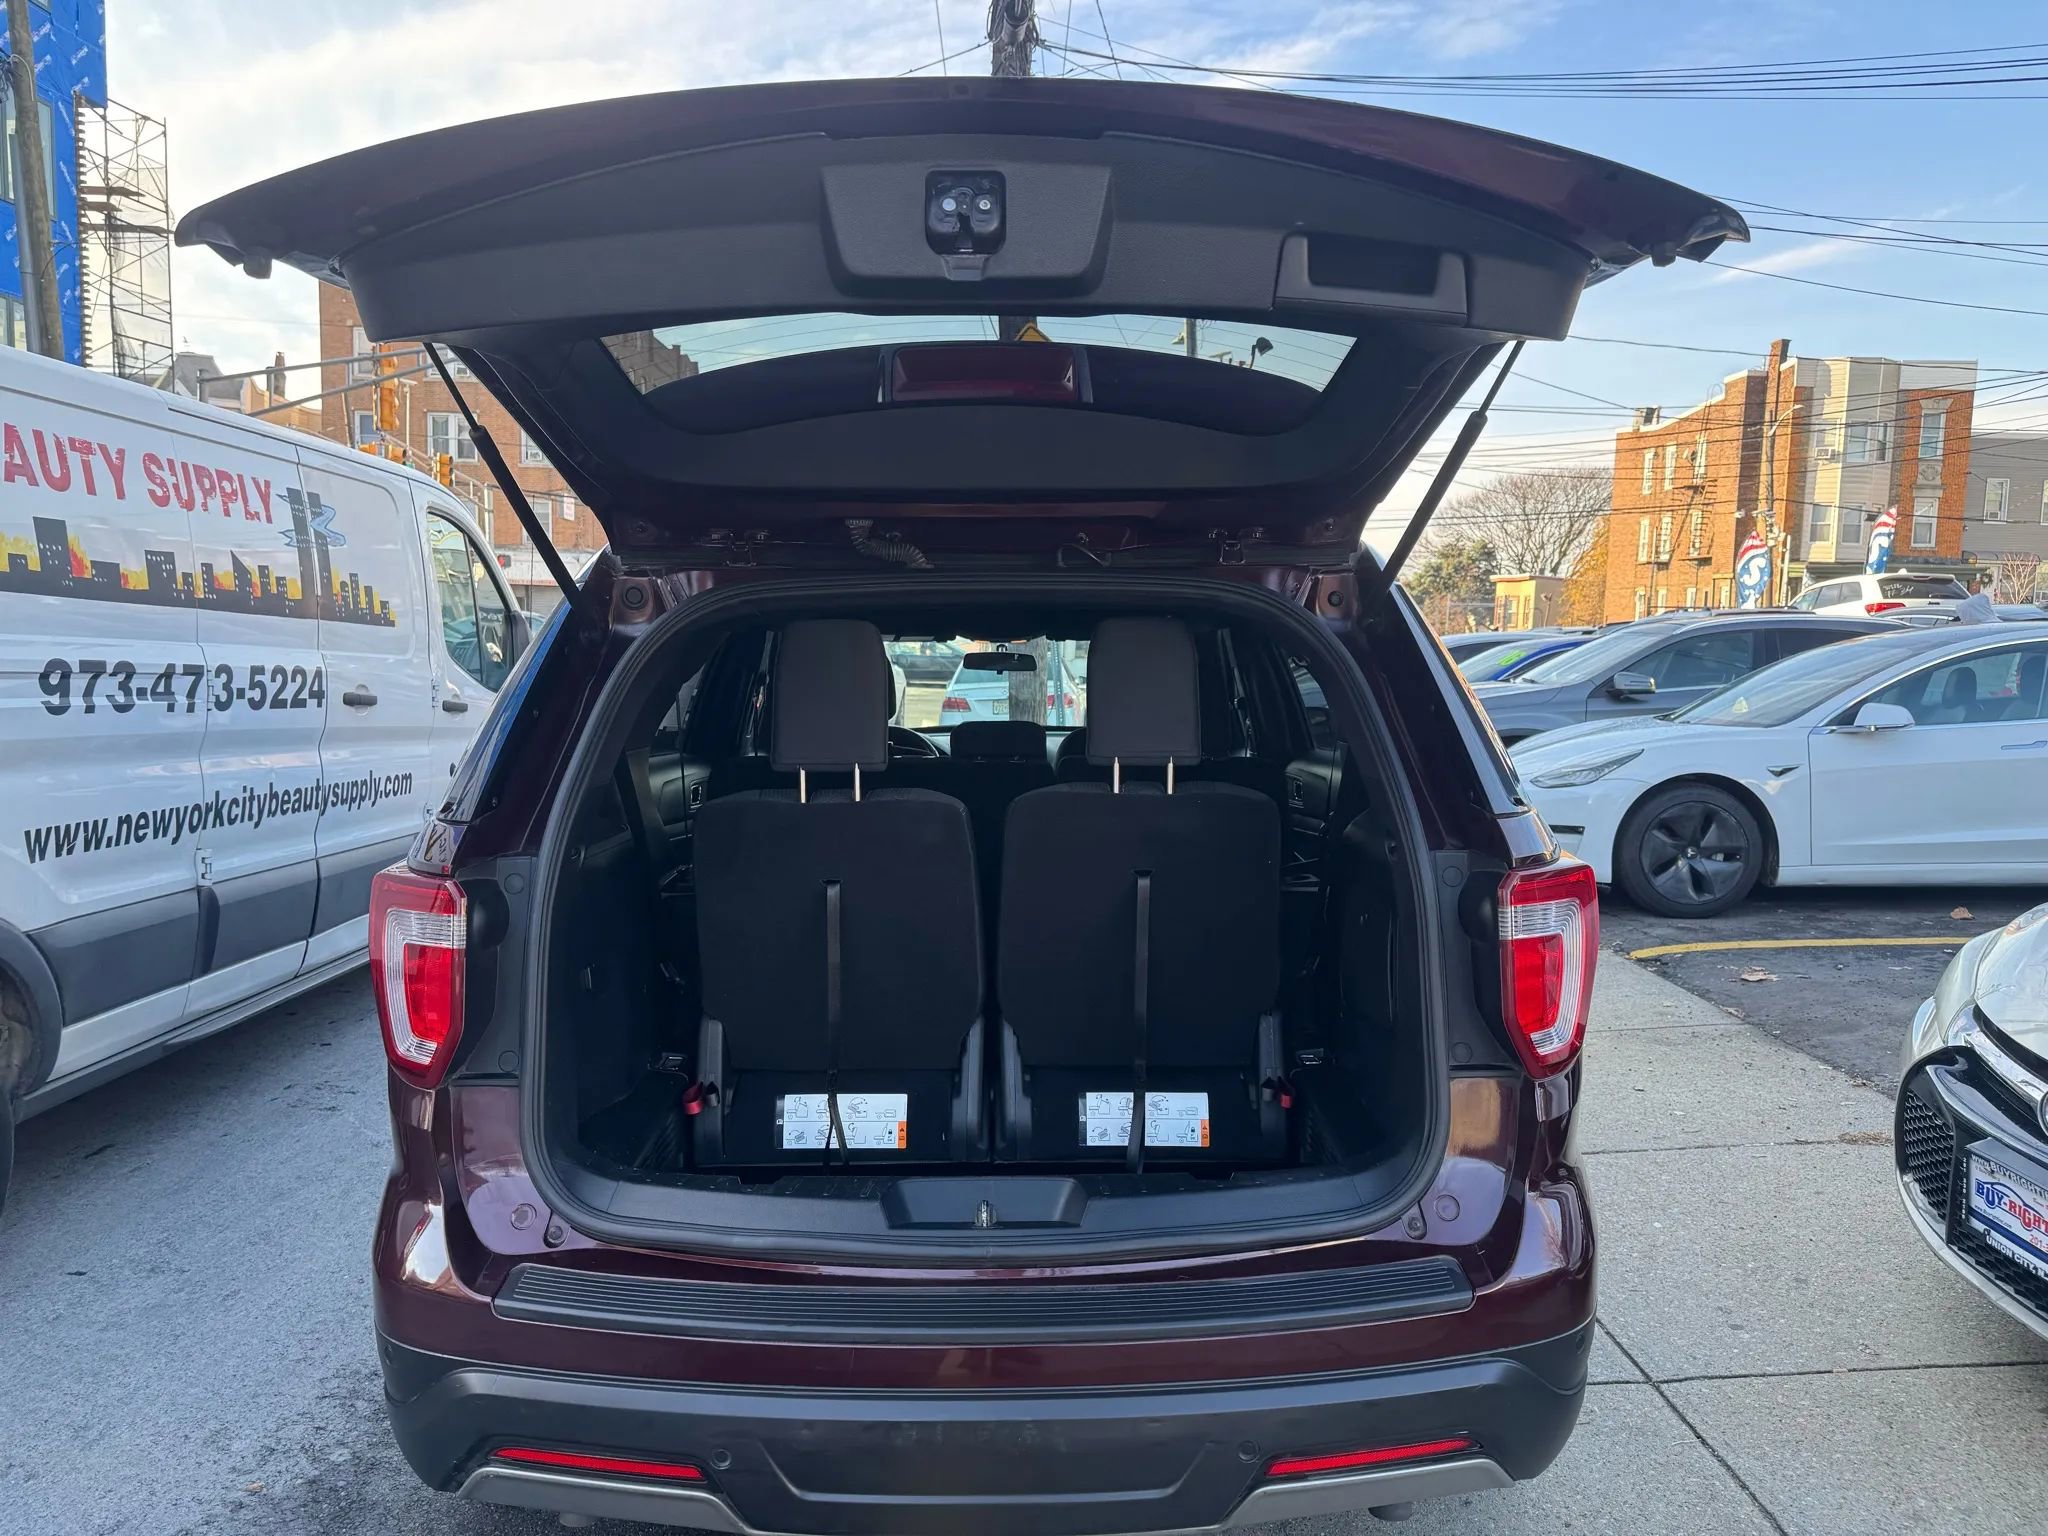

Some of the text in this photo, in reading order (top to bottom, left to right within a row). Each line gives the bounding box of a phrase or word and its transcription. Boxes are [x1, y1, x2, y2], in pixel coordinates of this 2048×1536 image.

[4, 422, 274, 524] AUTY SUPPLY
[38, 658, 326, 715] 973-473-5224
[24, 770, 413, 864] www.newyorkcitybeautysupply.com
[1986, 1235, 2013, 1258] UNION
